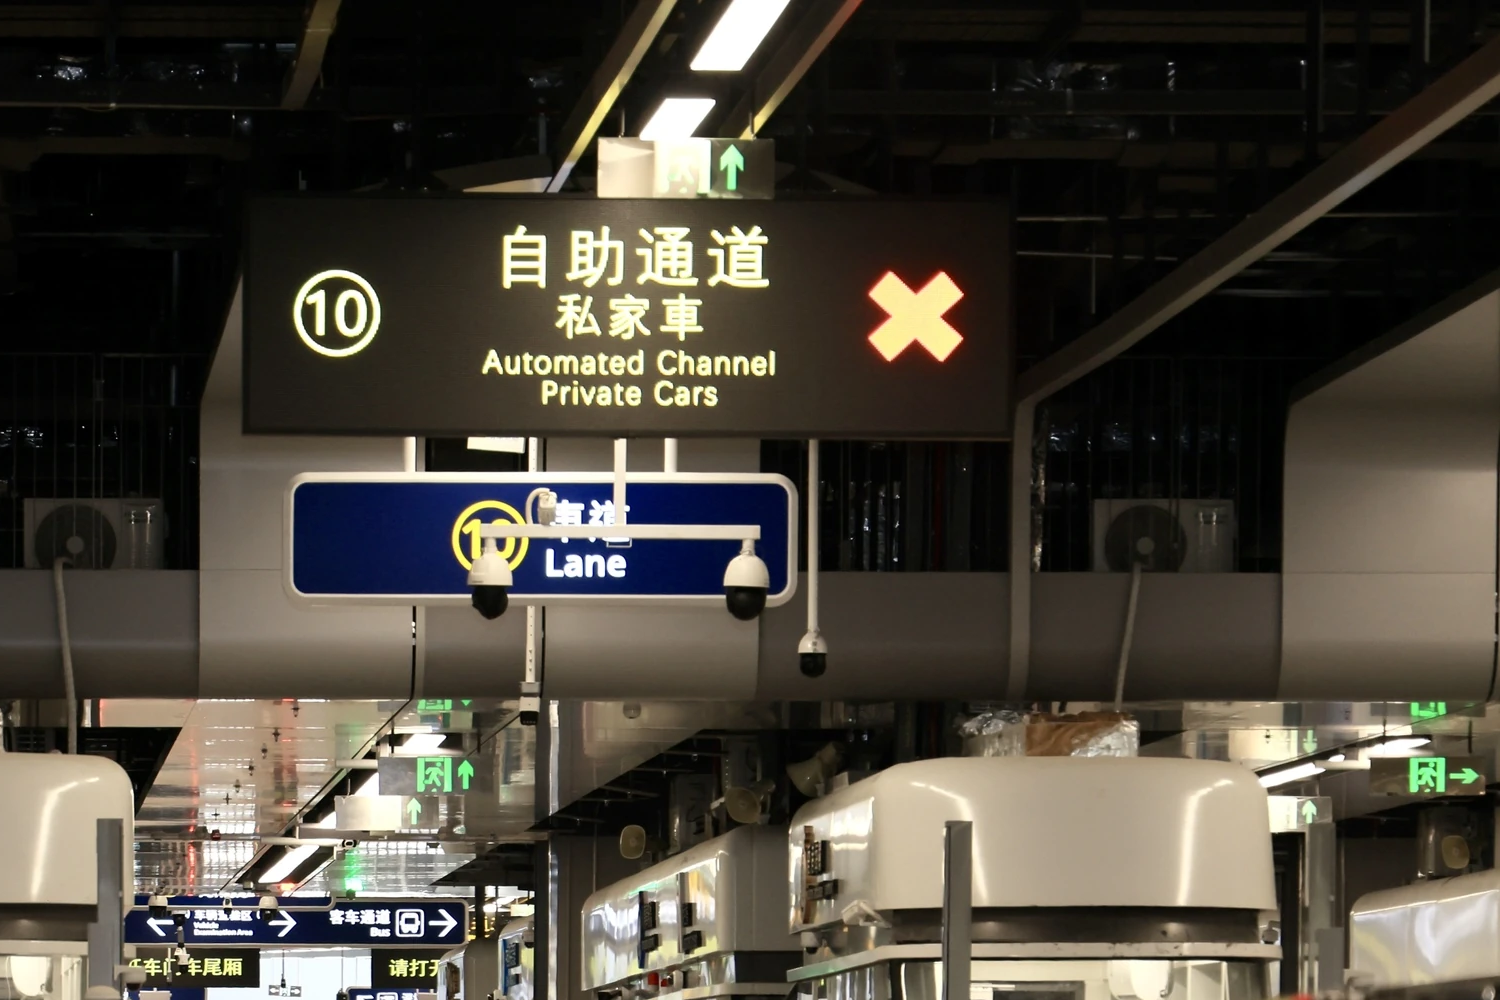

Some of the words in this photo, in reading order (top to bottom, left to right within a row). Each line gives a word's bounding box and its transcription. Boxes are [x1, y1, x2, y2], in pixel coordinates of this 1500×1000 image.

[501, 224, 770, 290] 自助通道
[306, 288, 368, 338] 10
[555, 294, 705, 341] 私家車
[482, 349, 645, 377] Automated
[656, 349, 776, 377] Channel
[541, 380, 643, 407] Private
[653, 380, 719, 407] Cars
[545, 547, 628, 578] Lane
[329, 909, 391, 925] 客车通道
[369, 927, 391, 937] Bus
